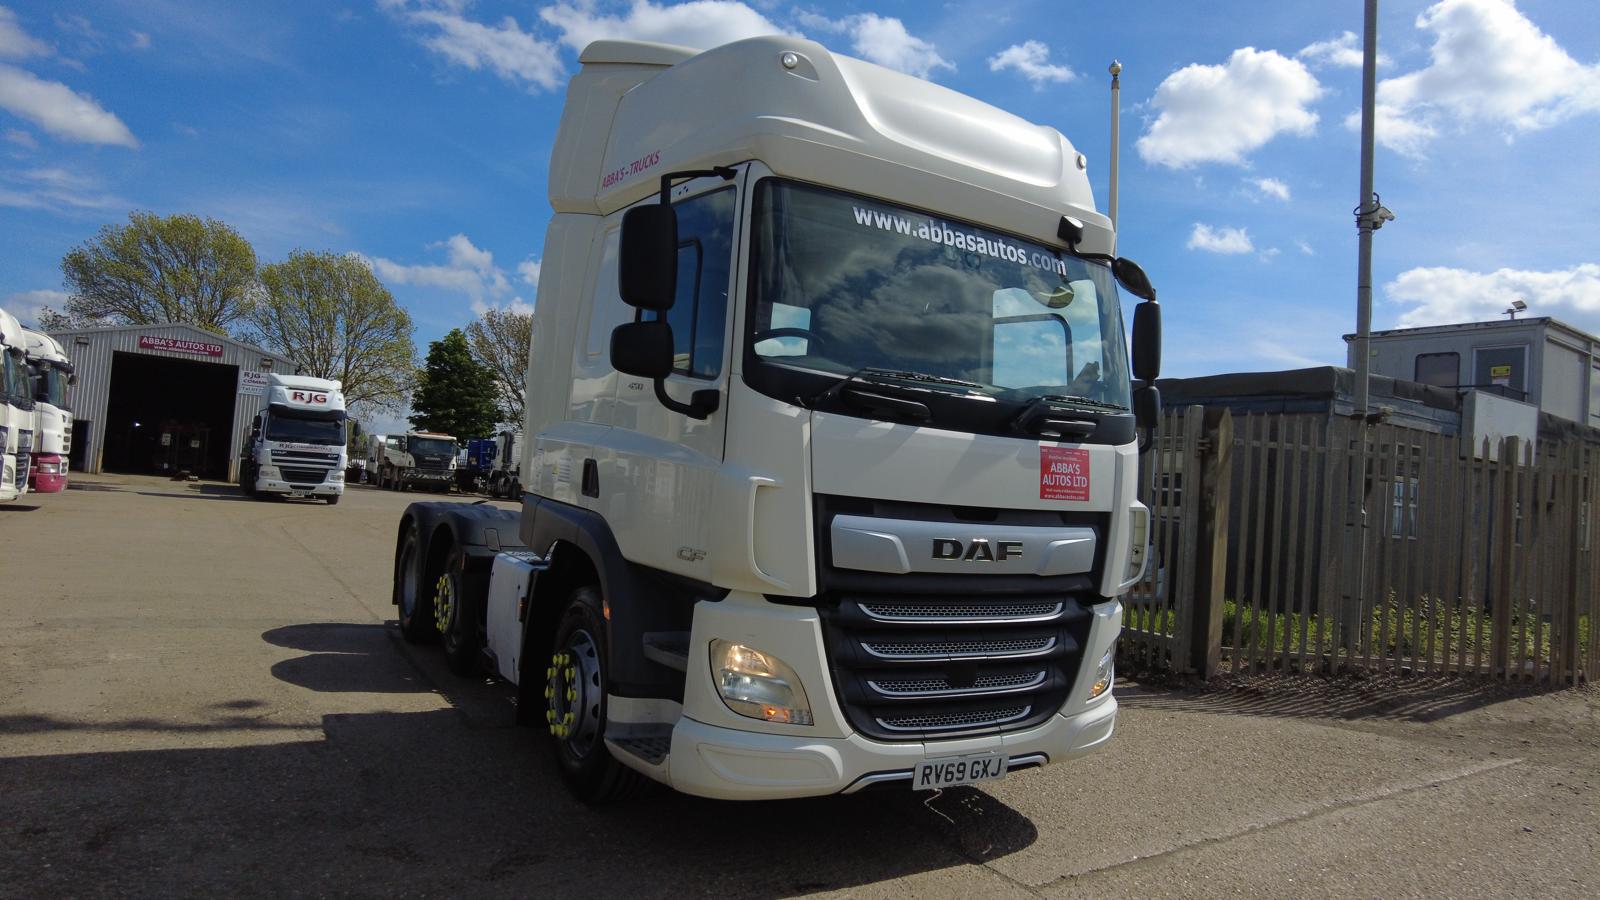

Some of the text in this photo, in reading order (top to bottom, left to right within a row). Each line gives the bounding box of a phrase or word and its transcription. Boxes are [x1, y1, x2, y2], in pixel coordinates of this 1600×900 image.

[853, 206, 1067, 275] www.abbasautos.com
[142, 336, 221, 352] ABBA'S AUTOS LTD
[292, 391, 327, 404] RJG
[1050, 462, 1081, 475] ABBA'S
[1042, 474, 1088, 488] AUTOS LTD
[932, 538, 1023, 561] DAF
[921, 757, 1002, 786] RV69 GXJ
